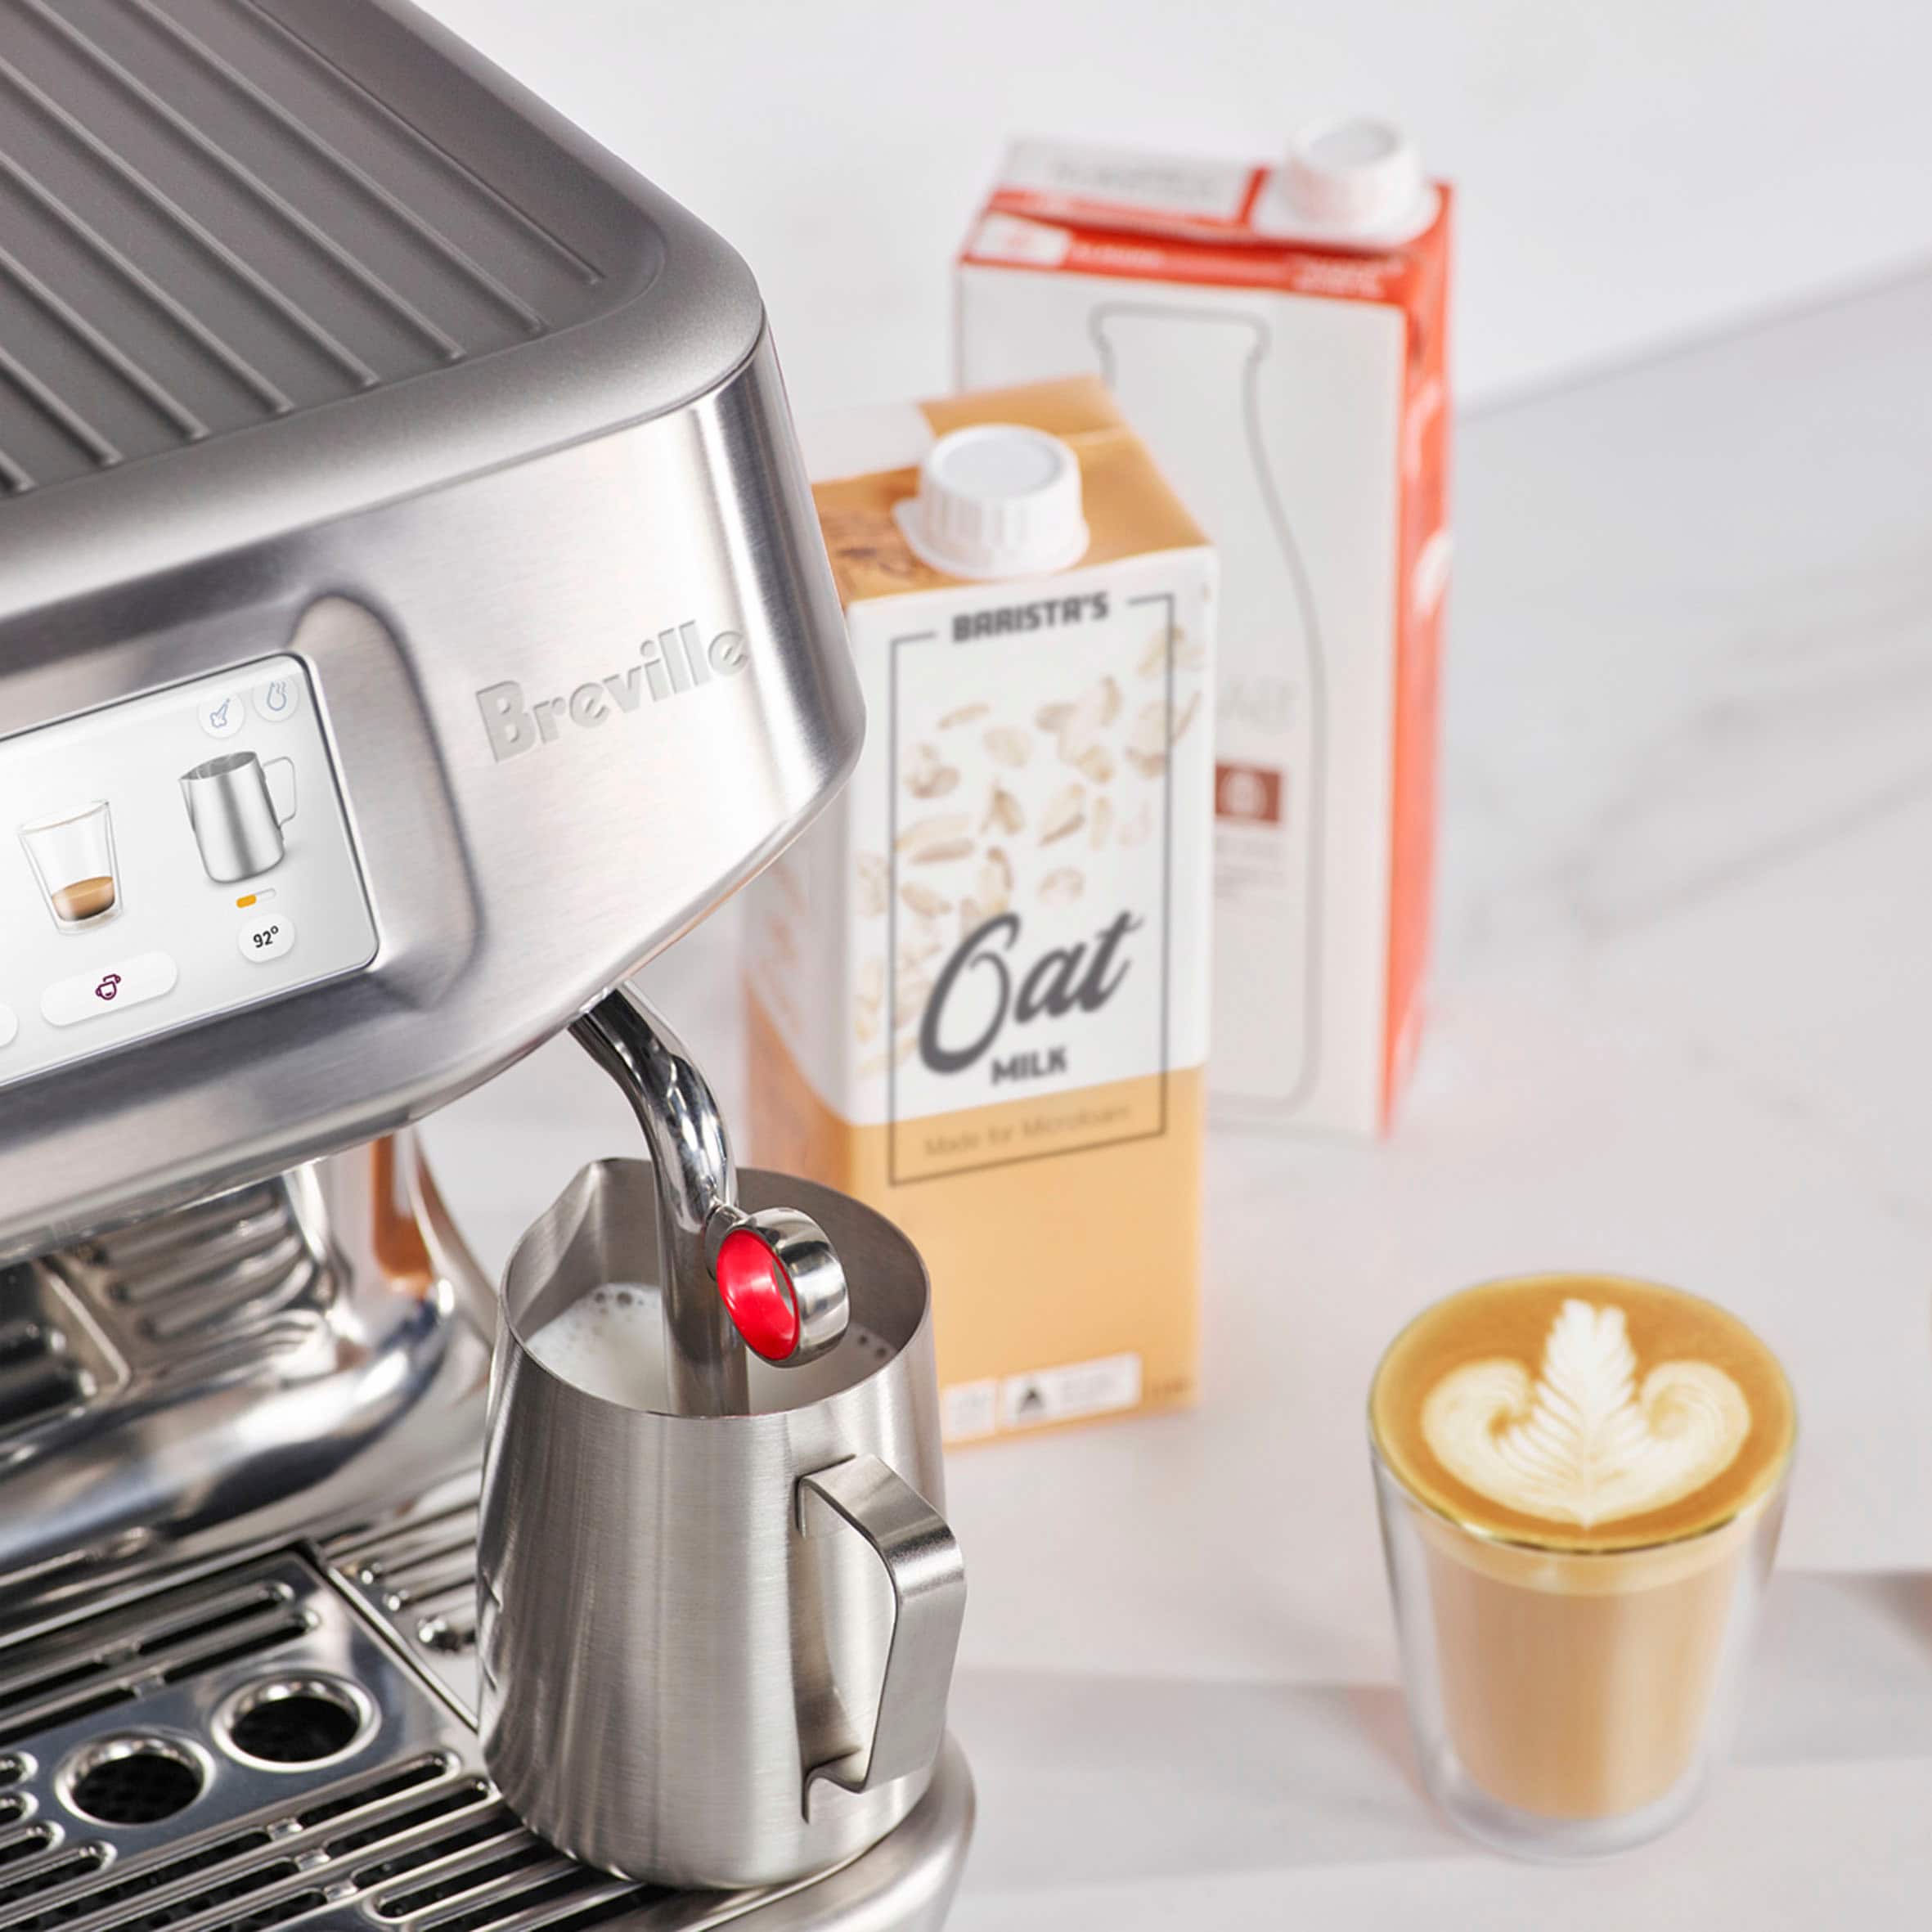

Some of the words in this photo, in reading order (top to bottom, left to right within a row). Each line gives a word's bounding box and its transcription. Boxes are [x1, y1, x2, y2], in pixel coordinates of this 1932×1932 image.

[950, 592, 1109, 644] BARISTA'S
[475, 619, 751, 763] Breville
[919, 910, 1143, 1076] Oat
[991, 1047, 1067, 1085] MILK
